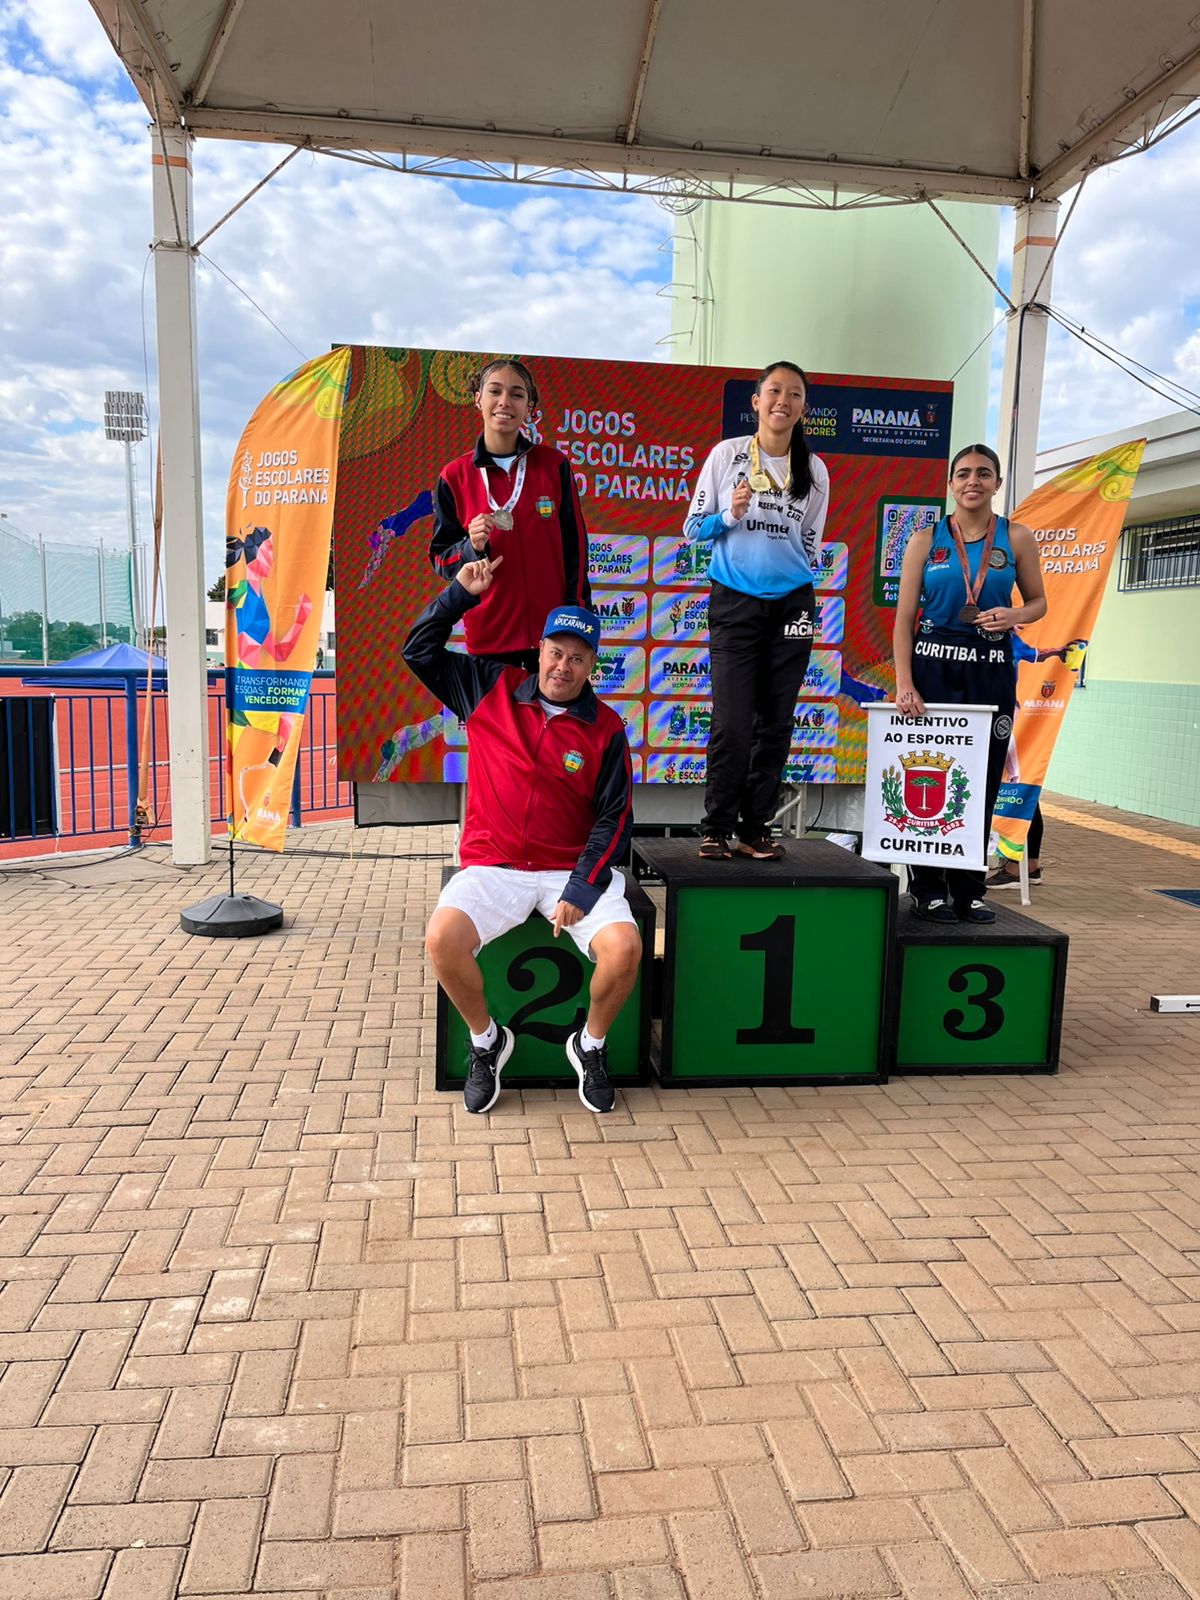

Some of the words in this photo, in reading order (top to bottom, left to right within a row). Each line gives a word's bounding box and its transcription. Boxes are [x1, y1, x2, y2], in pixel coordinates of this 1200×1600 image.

[557, 409, 636, 436] JOGOS
[852, 408, 921, 427] PARANÁ
[257, 450, 298, 468] JOGOS
[255, 468, 330, 487] ESCOLARES
[572, 473, 588, 497] O
[594, 471, 692, 501] PARANÁ
[254, 491, 271, 505] DO
[273, 484, 329, 504] PARANÁ
[1035, 528, 1077, 542] OGOS
[588, 543, 613, 553] OGOS
[1041, 540, 1107, 558] COLARES
[589, 554, 633, 564] SCOLARES
[1043, 553, 1099, 574] PARANÁ
[597, 563, 632, 574] PARANÁ
[554, 617, 586, 631] APUCARANA
[915, 641, 977, 662] CURITIBA
[989, 649, 1005, 663] PR
[235, 685, 266, 695] ESSOAS,
[237, 675, 308, 687] TRANSFORMANDO
[245, 695, 299, 705] VENCEDORES
[890, 715, 969, 728] INCENTIVO
[884, 733, 903, 743] AO
[907, 733, 974, 746] ESPORTE
[679, 761, 705, 770] JOGOS
[906, 818, 940, 828] CURITIBA
[880, 837, 965, 857] CURITIBA
[736, 915, 815, 1046] 1
[506, 946, 586, 1044] 2
[942, 964, 1006, 1041] 3
